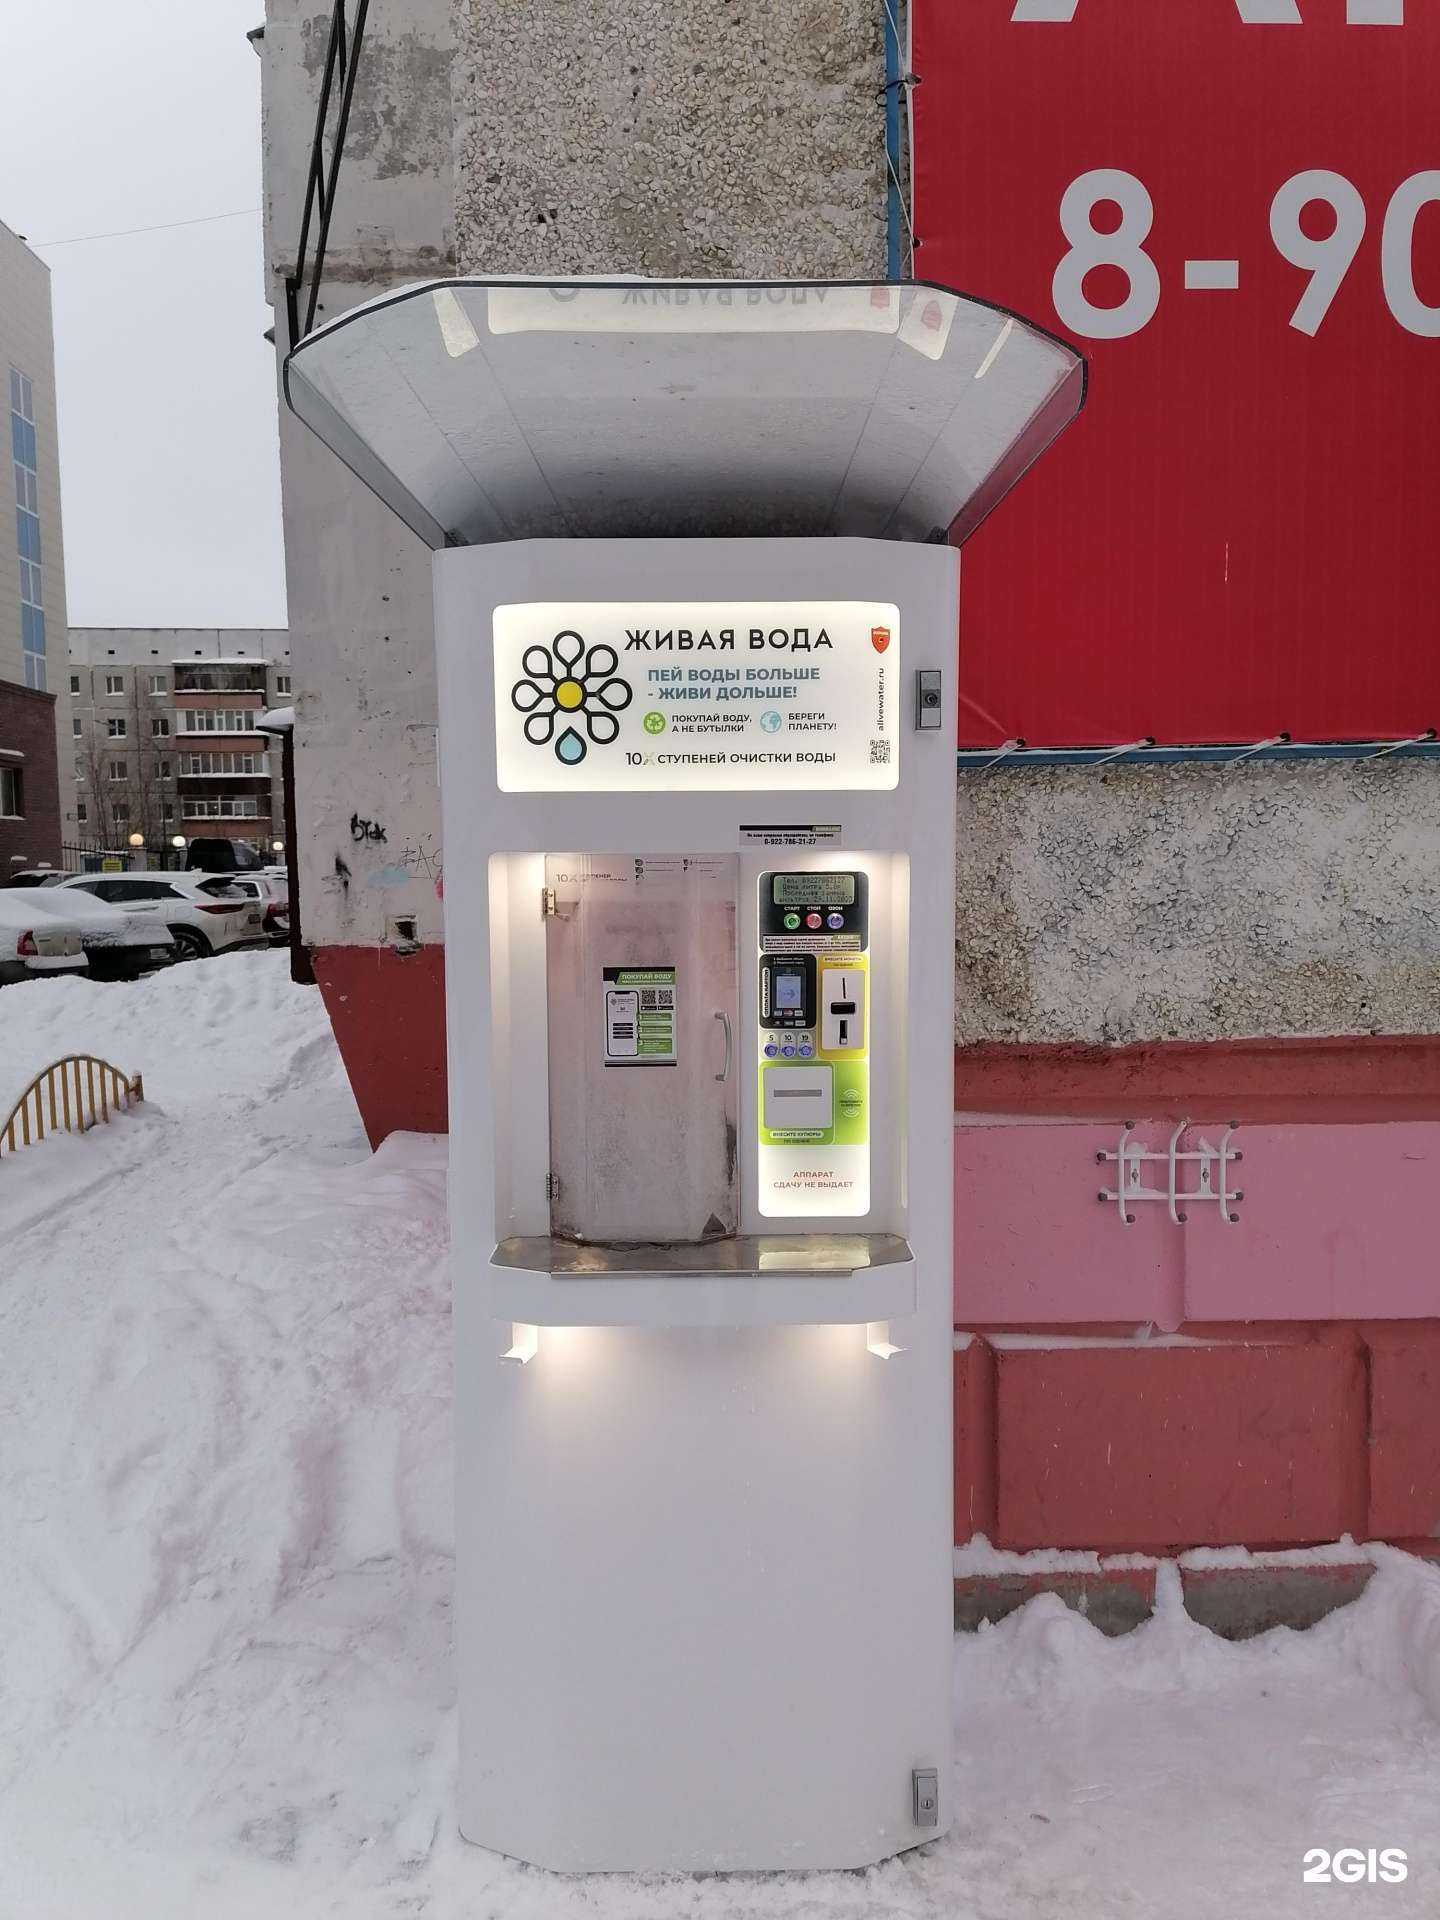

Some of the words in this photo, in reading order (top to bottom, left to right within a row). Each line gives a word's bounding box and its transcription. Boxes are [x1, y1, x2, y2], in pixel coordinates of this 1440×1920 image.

[624, 629, 735, 650] ЖИВАЯ
[749, 628, 833, 652] ВОДА
[648, 667, 682, 682] ПЕЙ
[688, 669, 740, 683] ВОДЫ
[746, 668, 820, 681] БОЛЬШЕ
[658, 687, 711, 700] ЖИВИ
[716, 686, 798, 701] ДОЛЬШЕ!
[877, 668, 885, 731] alivewater.ru
[672, 712, 720, 723] ПОКУПАЙ
[723, 714, 752, 724] ВОДУ,
[788, 713, 825, 721] БЕРЕГИ
[672, 724, 679, 733] А
[681, 724, 694, 733] НЕ
[697, 724, 745, 733] БУТЫЛКИ
[788, 722, 838, 731] ПЛАНЕТУ!
[657, 751, 726, 764] СТУПЕНЕЙ
[730, 753, 792, 763] ОЧИСТКИ
[797, 752, 836, 764] ВОДЫ
[773, 1181, 801, 1189] СДАЧУ
